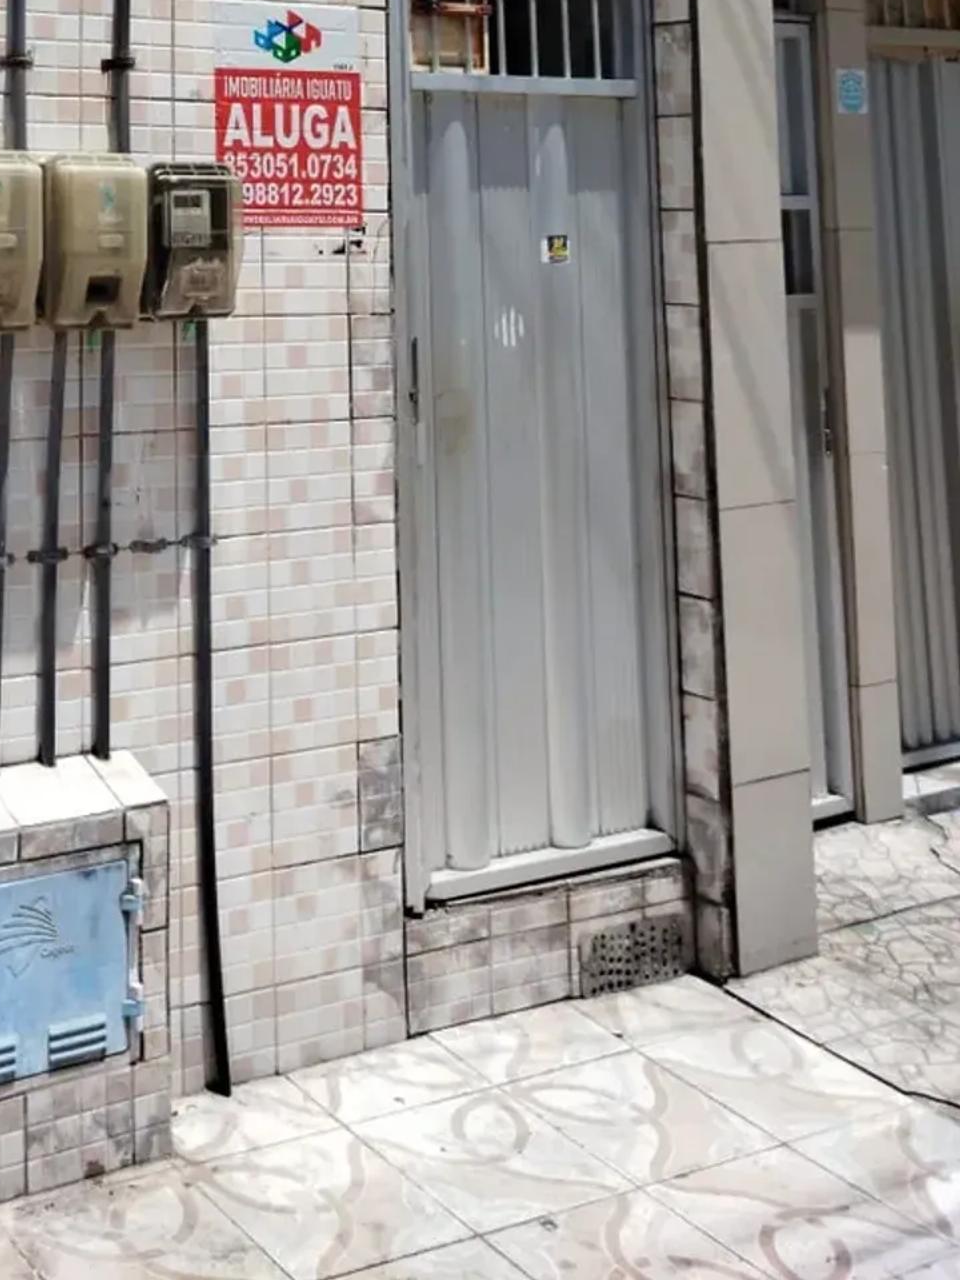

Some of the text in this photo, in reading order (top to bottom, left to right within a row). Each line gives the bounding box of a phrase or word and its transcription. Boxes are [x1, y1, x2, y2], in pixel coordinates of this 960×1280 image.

[224, 72, 352, 101] IMOBILIÁRIA IGUATU
[223, 102, 357, 149] ALUGA
